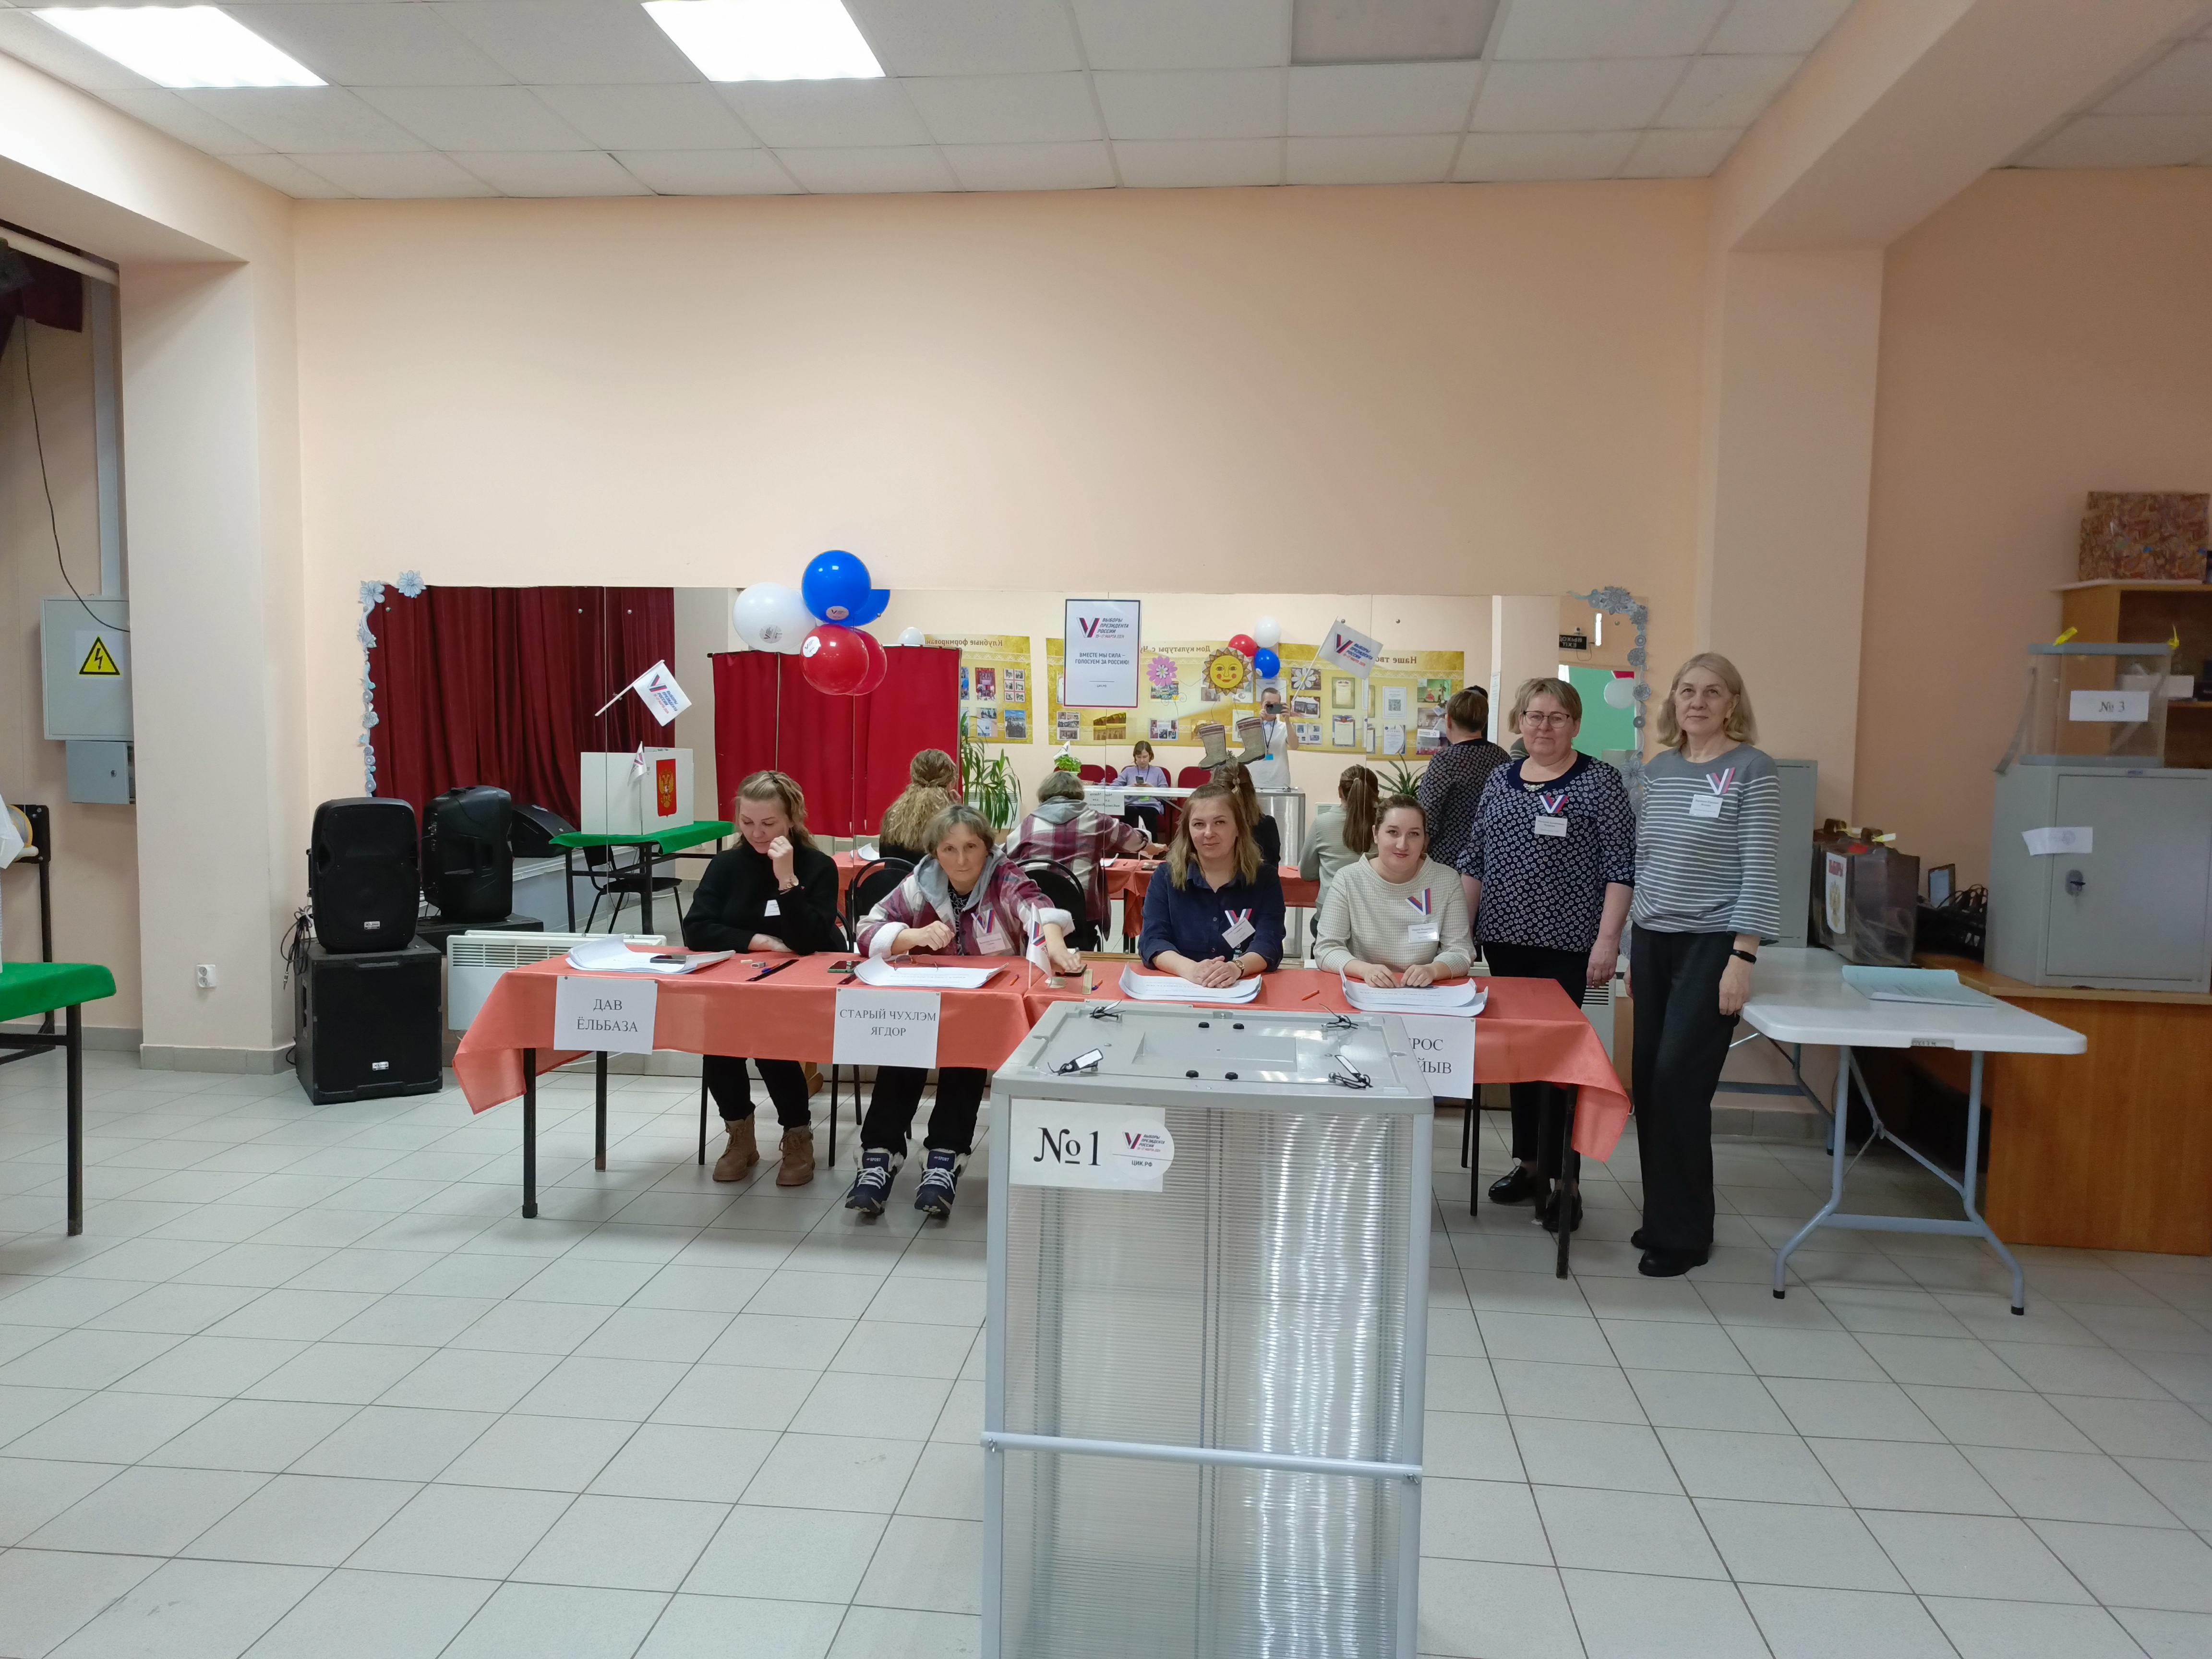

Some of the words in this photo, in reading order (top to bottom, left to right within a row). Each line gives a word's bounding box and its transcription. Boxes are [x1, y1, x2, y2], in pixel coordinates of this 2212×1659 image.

[593, 998, 623, 1011] ДАВ
[840, 1008, 886, 1020] СТАРЫЙ
[889, 1010, 937, 1022] ЧУХЛЭМ
[577, 1016, 638, 1033] ЁЛЬБАЗА
[870, 1026, 906, 1037] ЯГДОР
[1408, 1038, 1443, 1051] РОС
